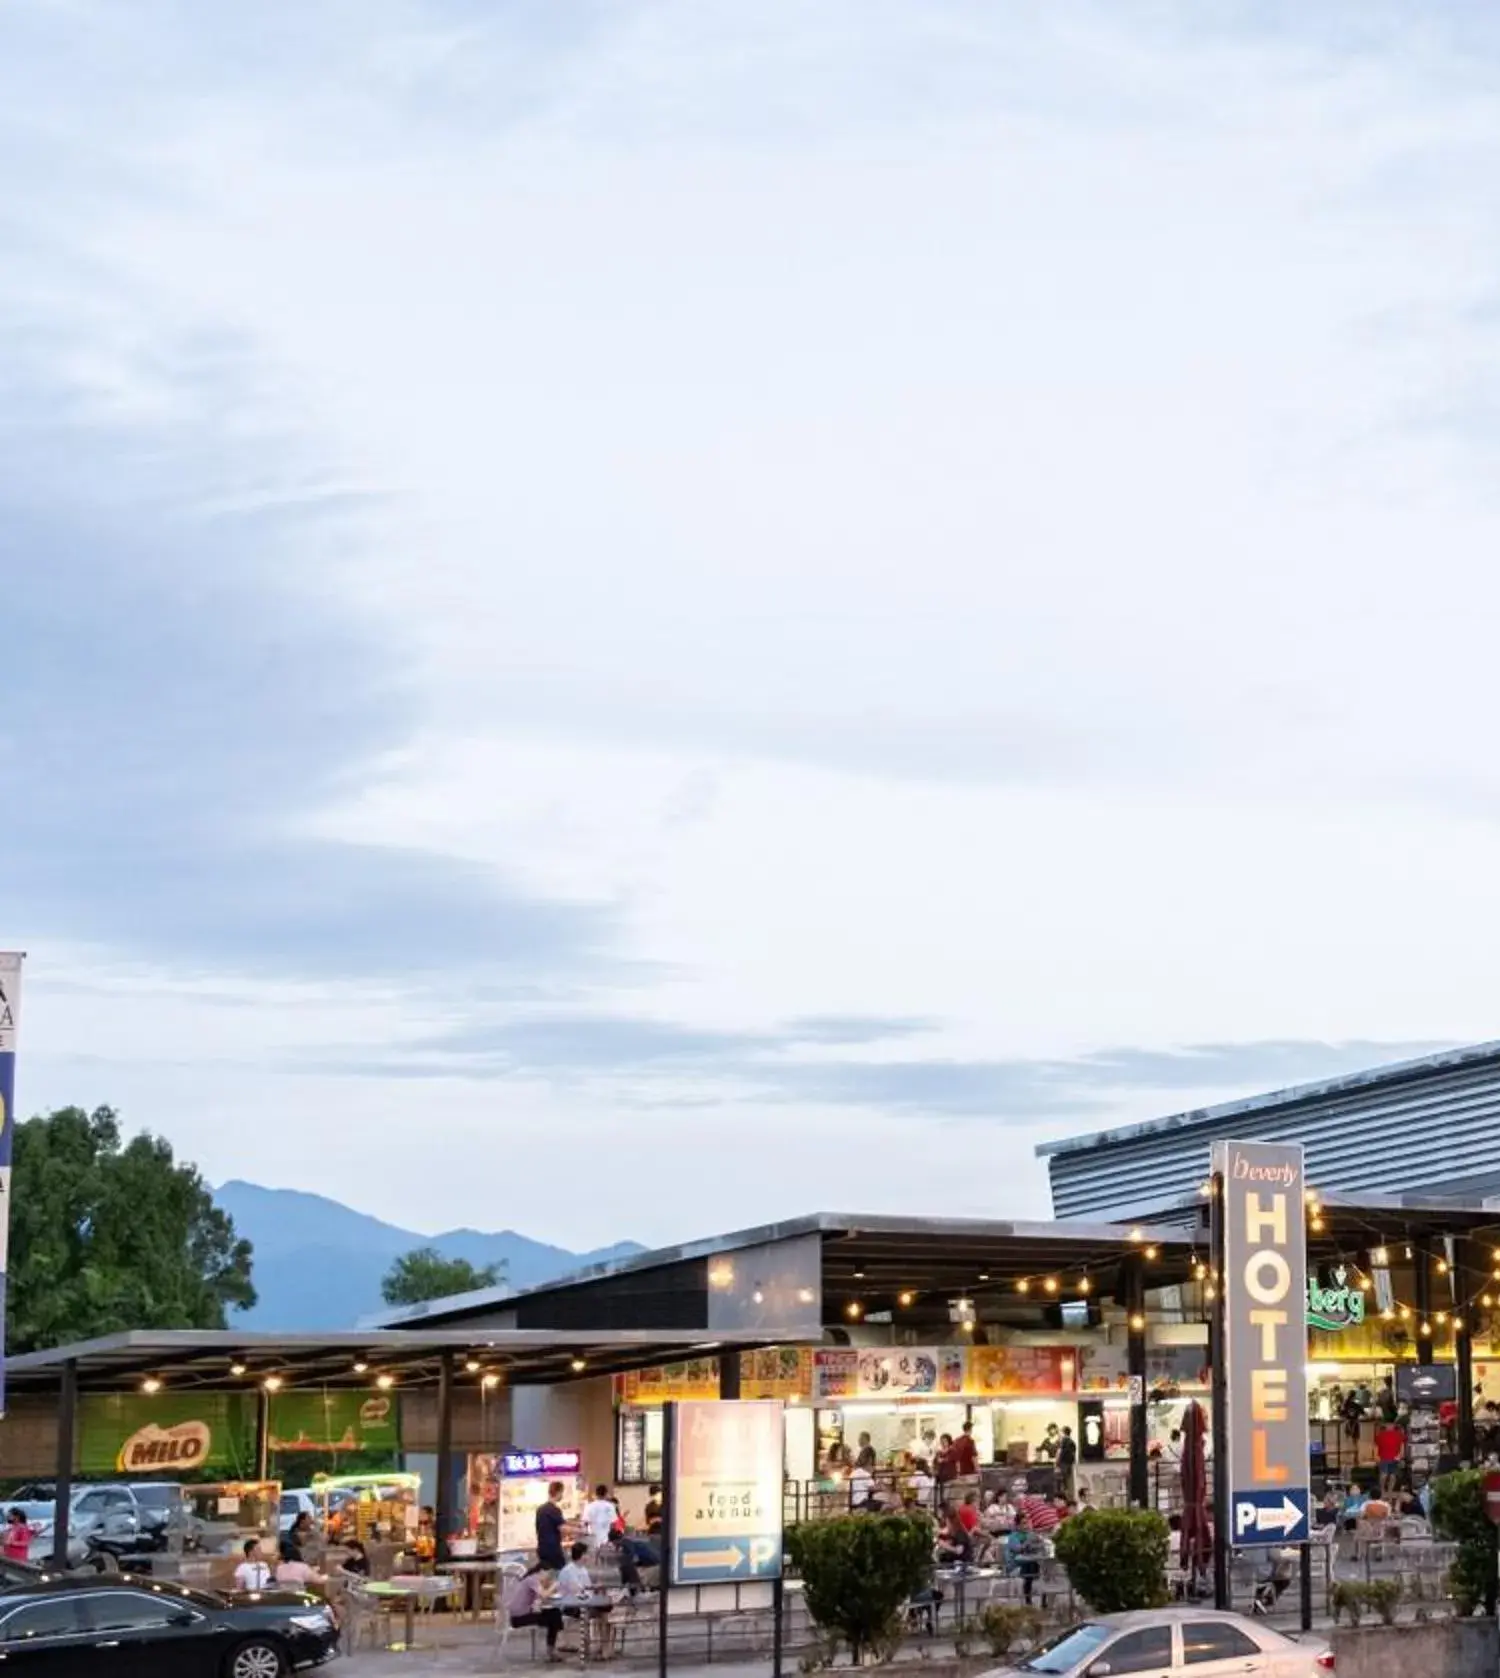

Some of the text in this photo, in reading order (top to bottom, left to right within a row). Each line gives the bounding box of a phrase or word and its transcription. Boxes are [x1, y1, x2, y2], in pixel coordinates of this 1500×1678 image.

[1232, 1151, 1298, 1188] beverly
[1244, 1191, 1290, 1485] HOTEL
[131, 1437, 202, 1465] MILO
[695, 1506, 763, 1520] avenue
[708, 1491, 751, 1506] food
[1236, 1502, 1256, 1536] P
[749, 1539, 775, 1574] P
